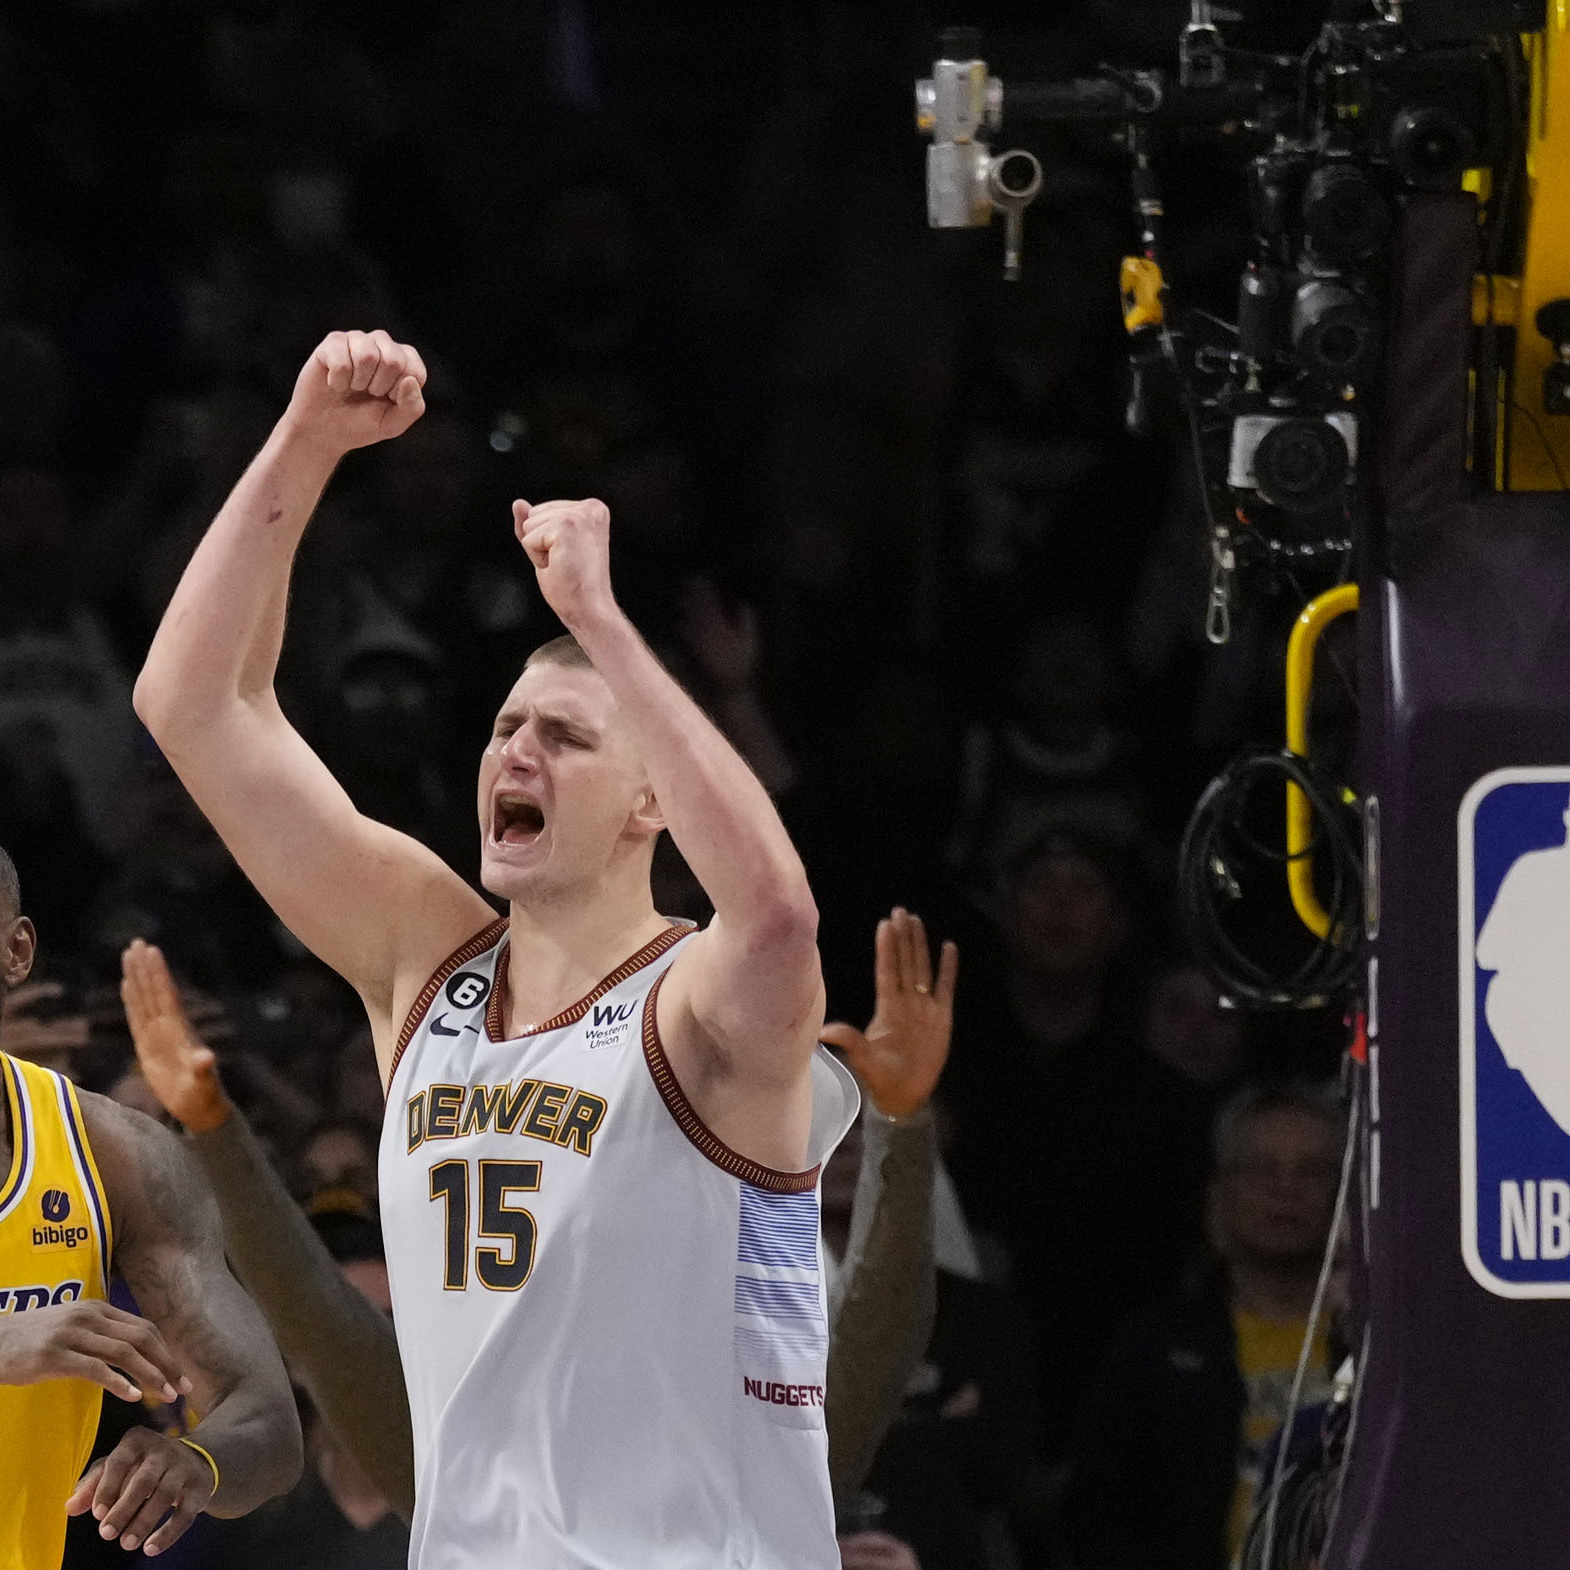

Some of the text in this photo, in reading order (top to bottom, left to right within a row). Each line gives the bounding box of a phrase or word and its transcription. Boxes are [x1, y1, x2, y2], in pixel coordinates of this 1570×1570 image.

[452, 976, 485, 1007] 6
[593, 999, 639, 1027] WU
[585, 1023, 629, 1040] Western
[589, 1034, 620, 1049] Union
[406, 1078, 608, 1156] DENVER
[428, 1159, 544, 1292] 15
[1500, 1179, 1570, 1261] NB
[32, 1225, 89, 1248] bibigo
[743, 1375, 824, 1407] NUGGETS
